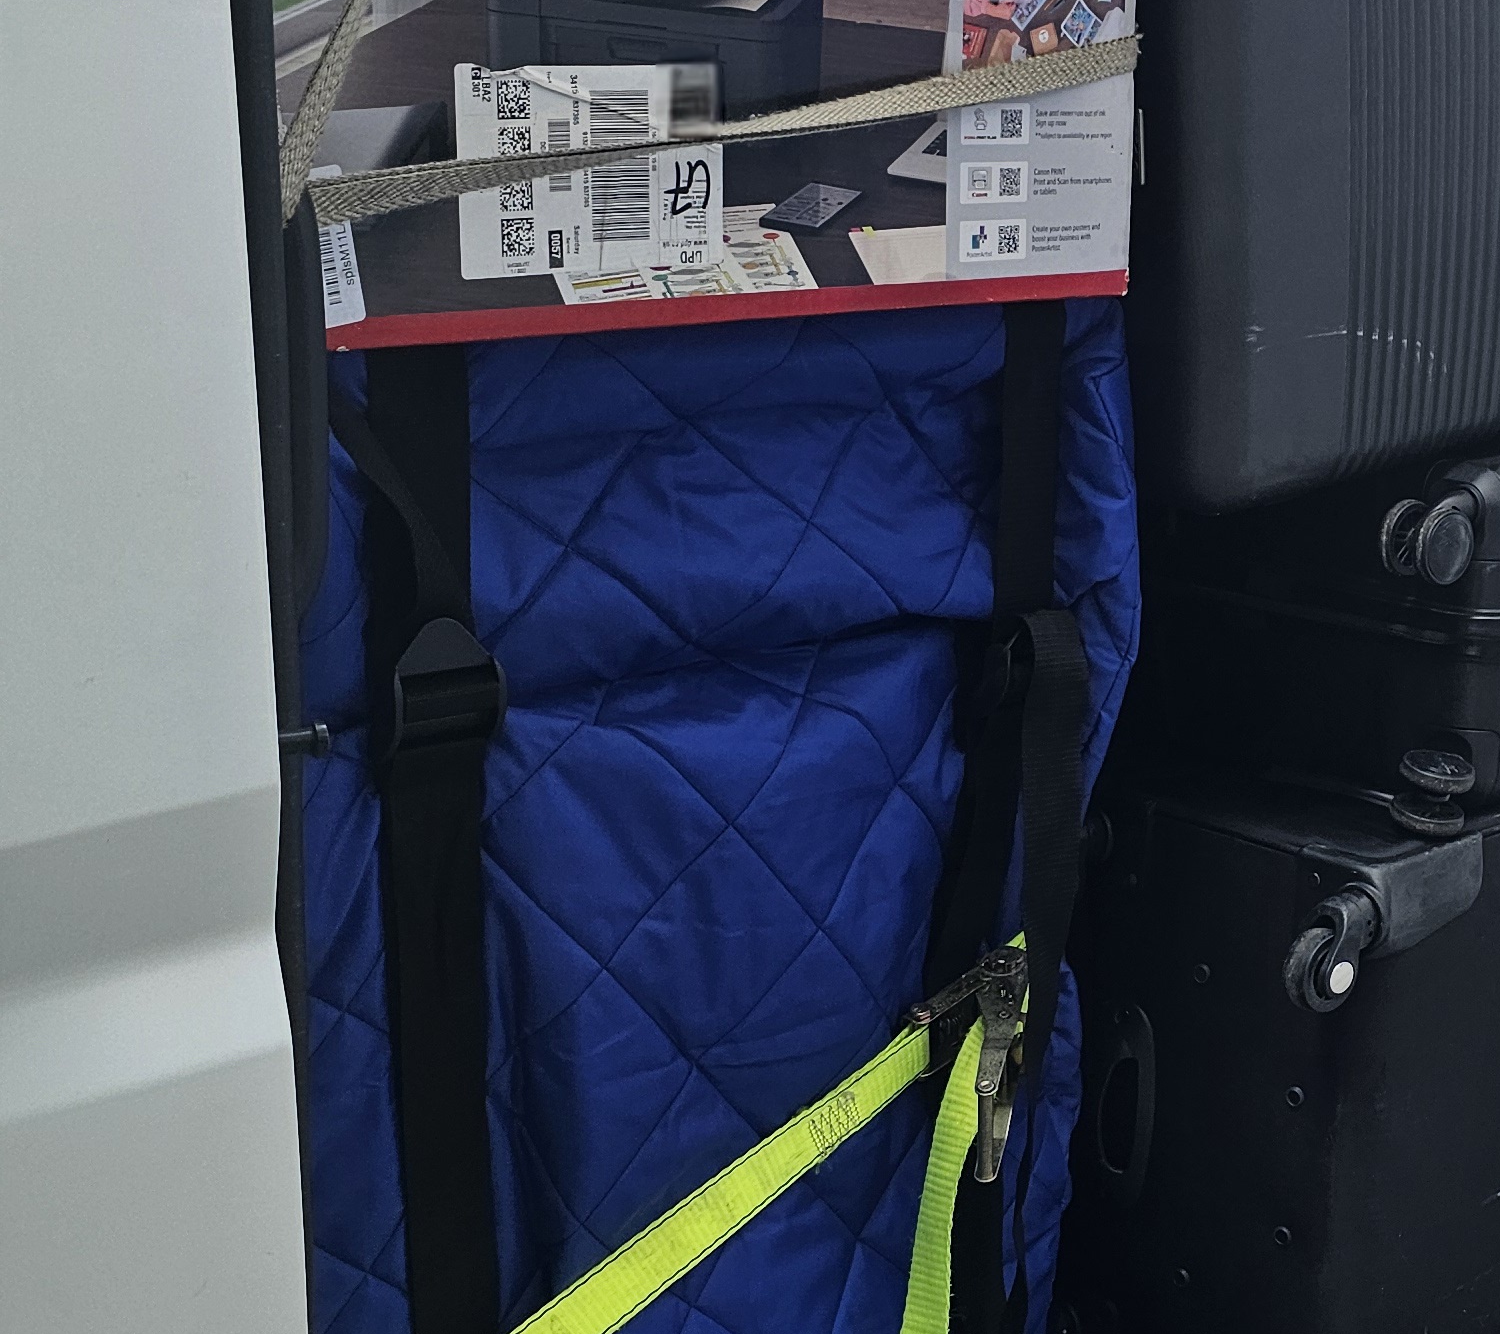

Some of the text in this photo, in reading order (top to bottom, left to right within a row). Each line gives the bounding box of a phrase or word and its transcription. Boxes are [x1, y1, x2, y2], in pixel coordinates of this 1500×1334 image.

[471, 81, 481, 98] 301
[1033, 167, 1066, 176] Canon PRINT
[1033, 177, 1046, 185] Print
[1057, 177, 1069, 185] Scan
[550, 233, 562, 259] 0057
